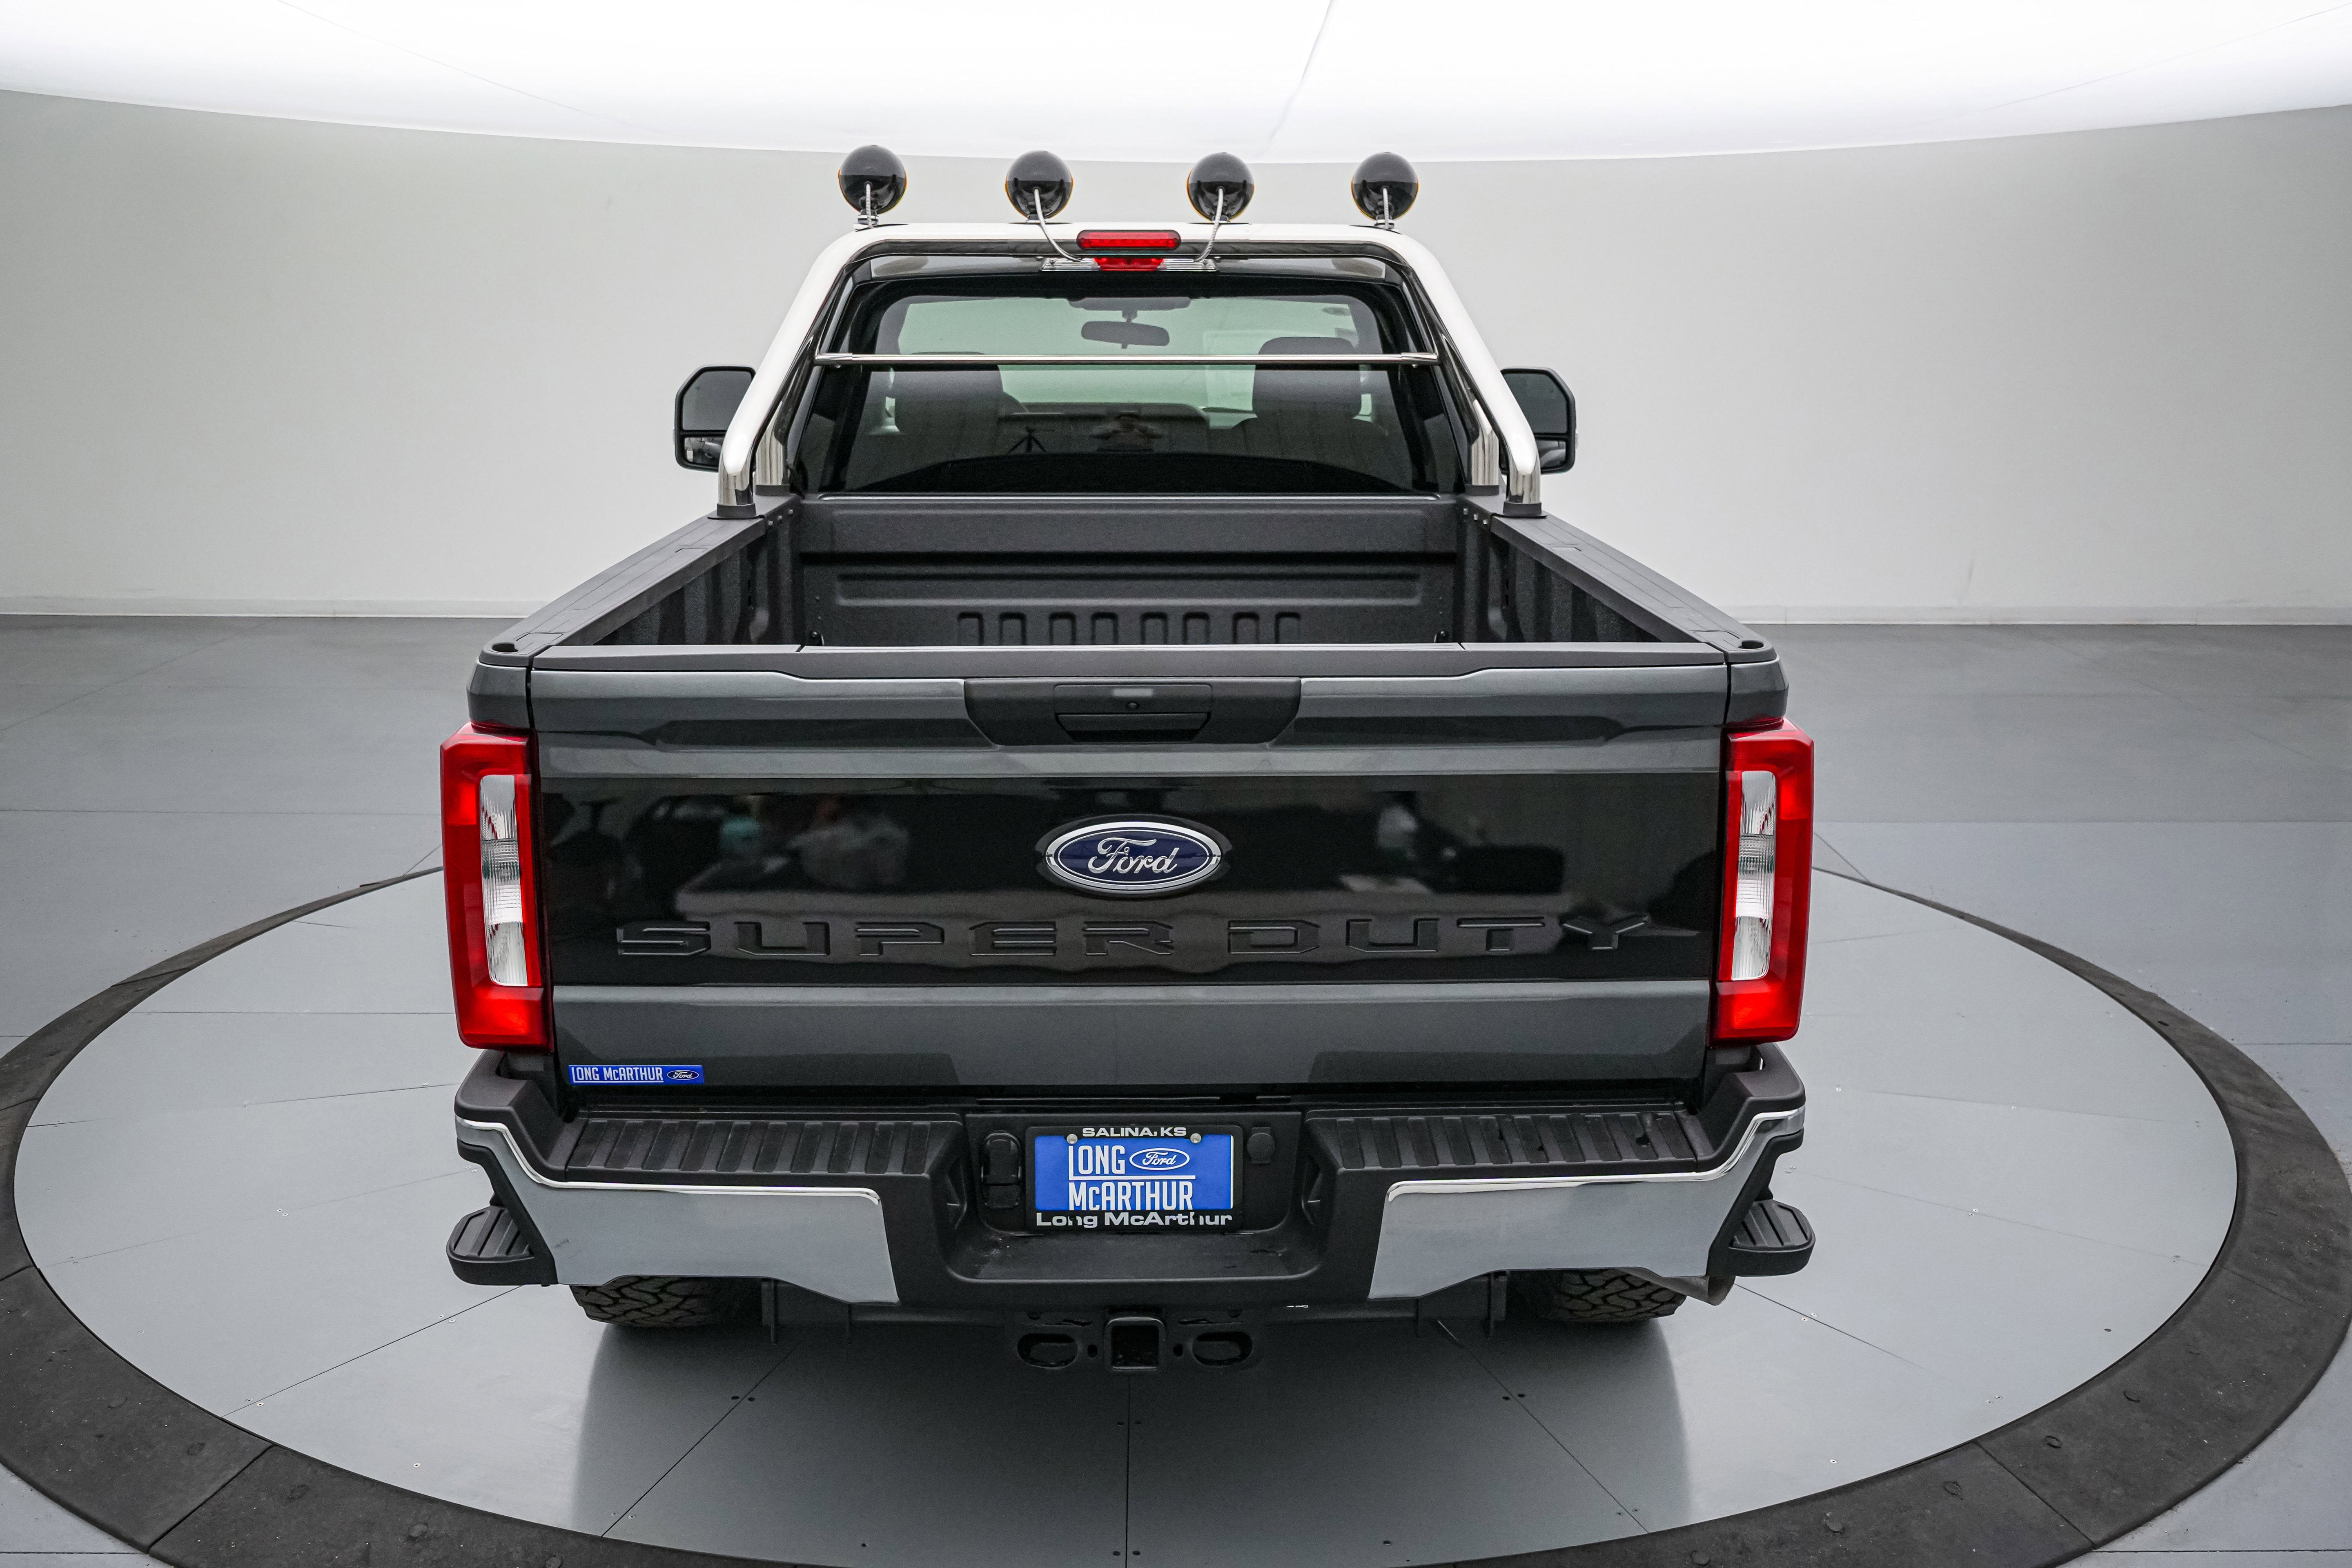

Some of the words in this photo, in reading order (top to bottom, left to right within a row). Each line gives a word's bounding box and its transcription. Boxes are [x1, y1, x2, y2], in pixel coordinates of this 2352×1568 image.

[1087, 837, 1180, 874] Ford
[616, 920, 1174, 956] SUPER
[1227, 916, 1650, 954] DUTY
[572, 1067, 599, 1082] LONG
[603, 1067, 664, 1080] McARTHUR
[1082, 1127, 1157, 1137] SALINA,
[1160, 1127, 1187, 1136] KS
[1068, 1145, 1125, 1179] LONG
[1142, 1151, 1176, 1166] Ford
[1069, 1181, 1193, 1210] McARTHUR
[1036, 1212, 1098, 1228] Long
[1105, 1212, 1232, 1226] McArthur
